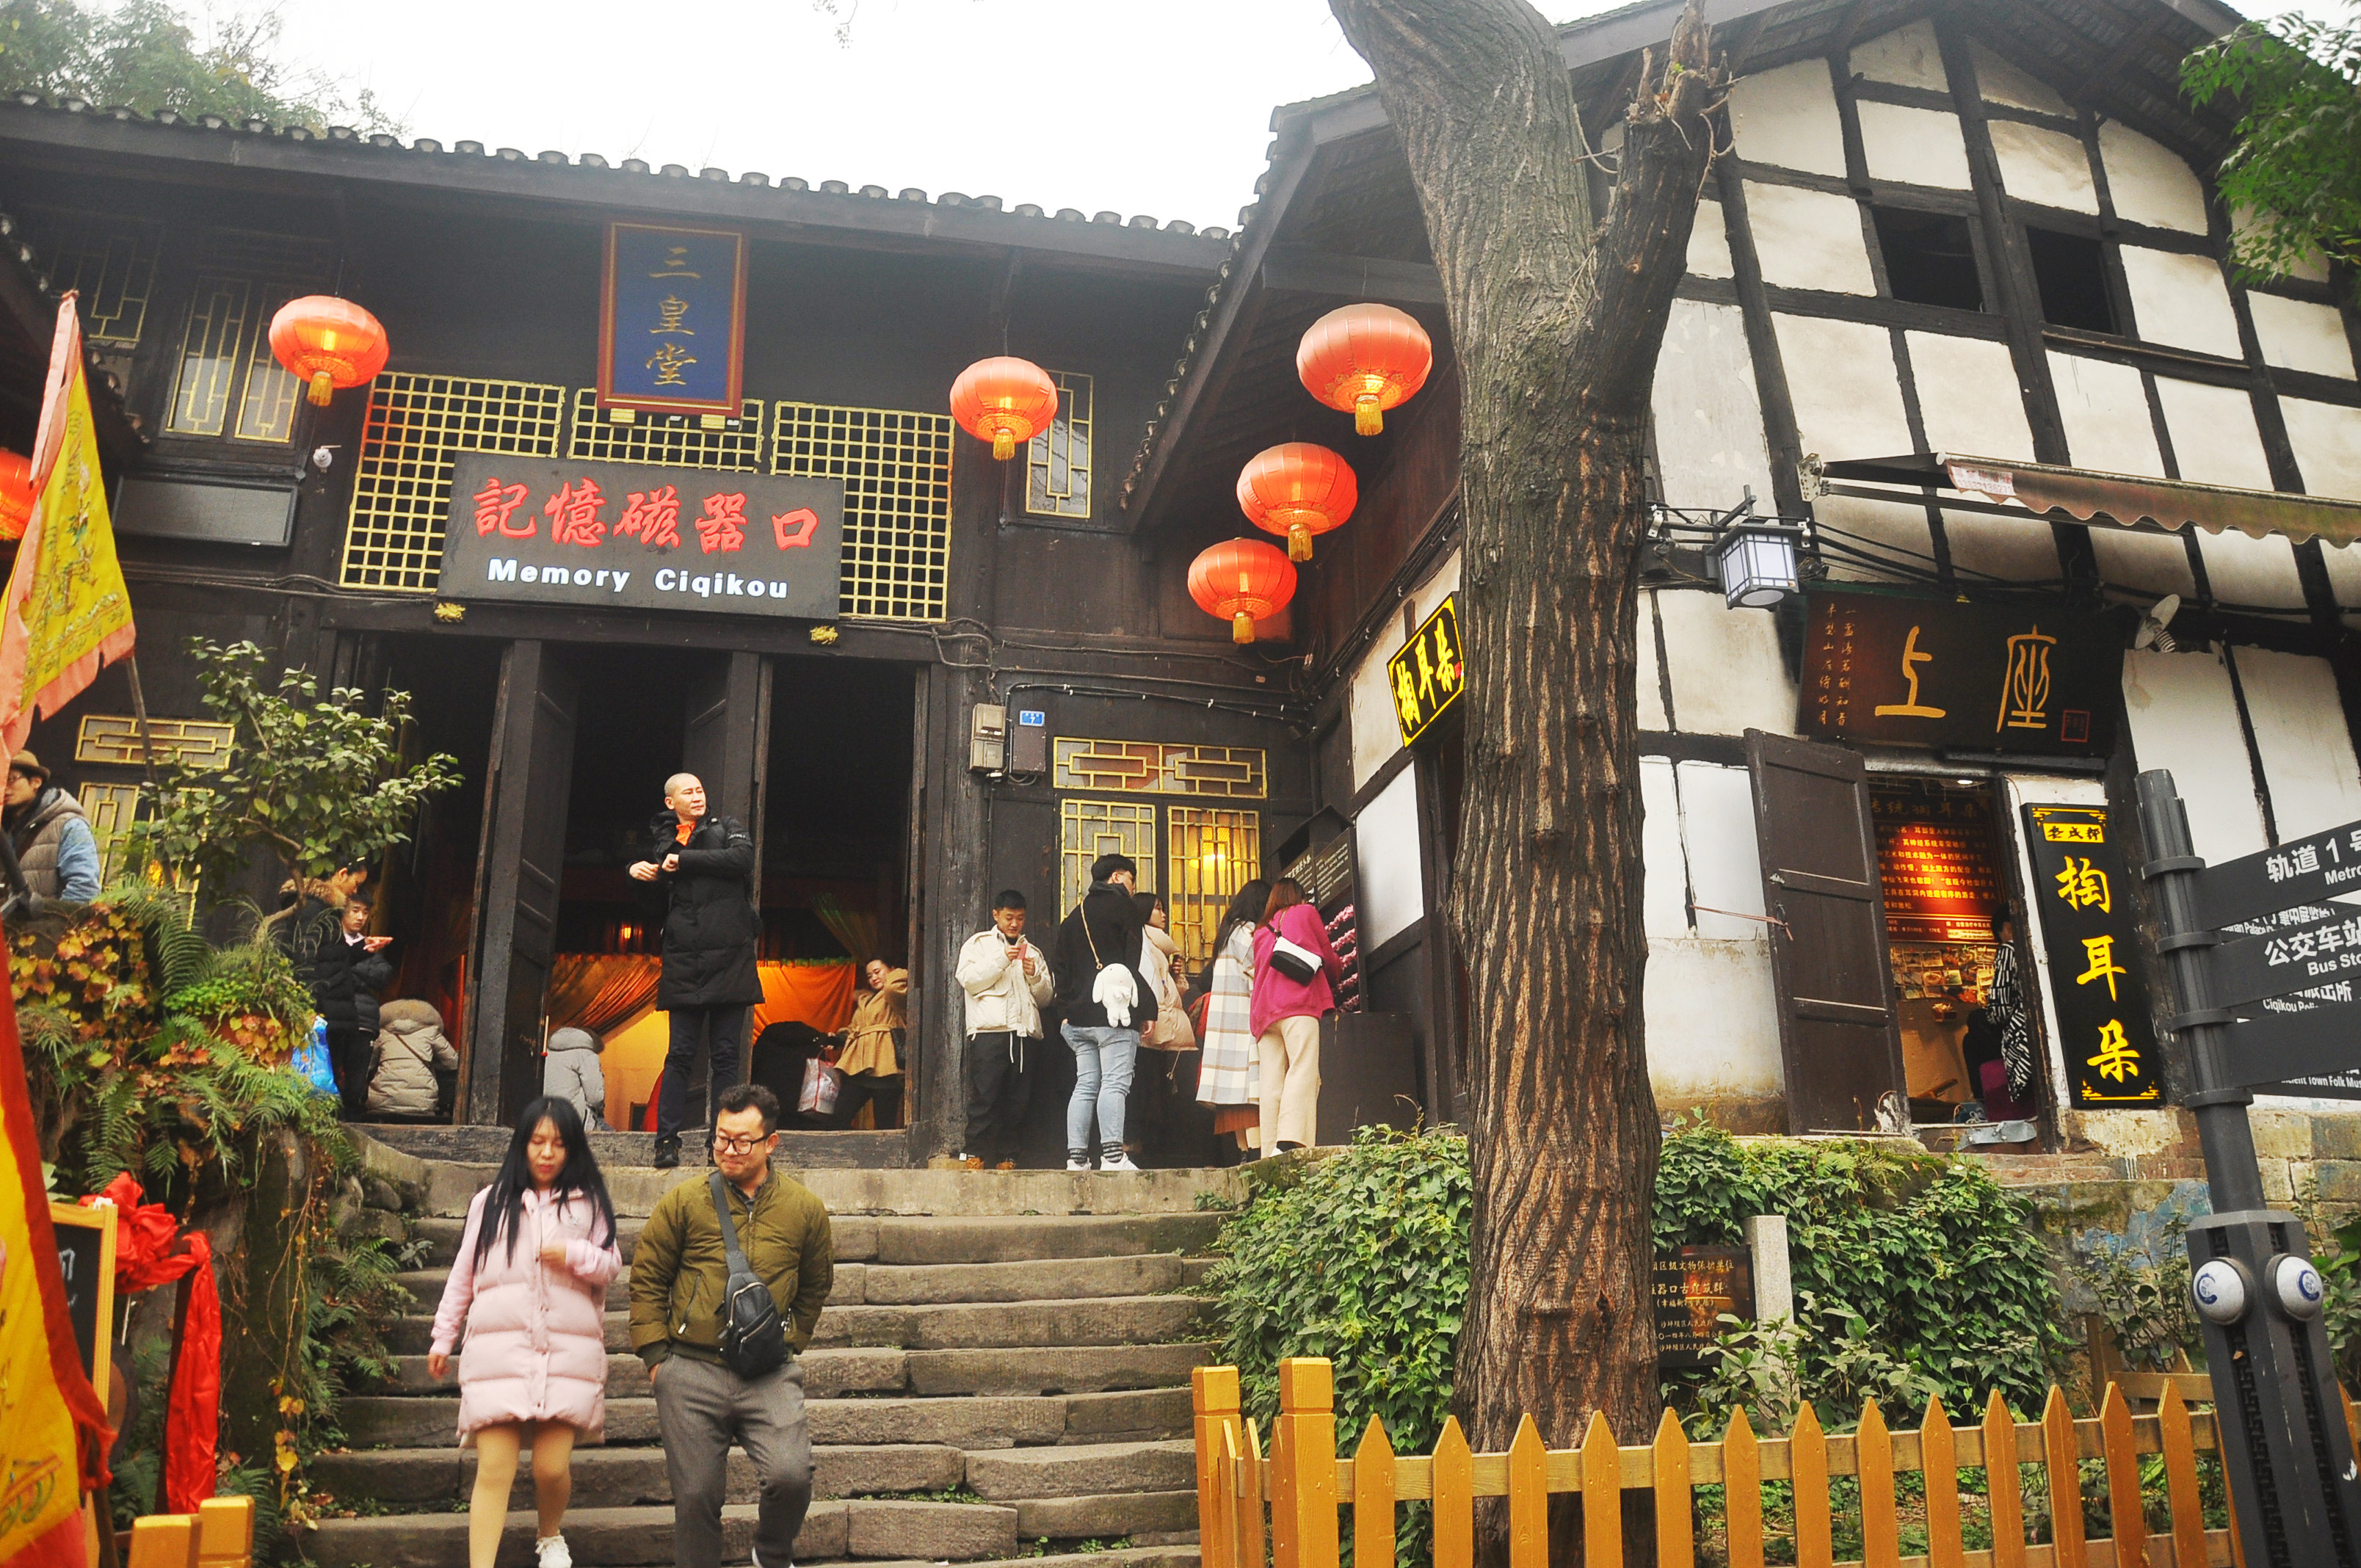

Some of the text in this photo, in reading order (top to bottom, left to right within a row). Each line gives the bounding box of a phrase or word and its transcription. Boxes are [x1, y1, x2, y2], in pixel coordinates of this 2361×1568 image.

[646, 247, 701, 385] 三皇堂
[473, 477, 819, 554] 記憶磁器口
[487, 557, 788, 600] Memory Ciqikou
[1396, 617, 1456, 732] 掏耳朵
[1029, 716, 1036, 724] 7
[2047, 826, 2103, 841] 老成都
[2324, 865, 2361, 885] Metro
[2265, 916, 2361, 967] 公交车站
[2055, 855, 2141, 1084] 掏耳朵
[2307, 959, 2338, 976] Bus
[2289, 981, 2352, 1002] 派出所
[2263, 998, 2297, 1013] Ciqikou
[2328, 1075, 2346, 1087] Folk
